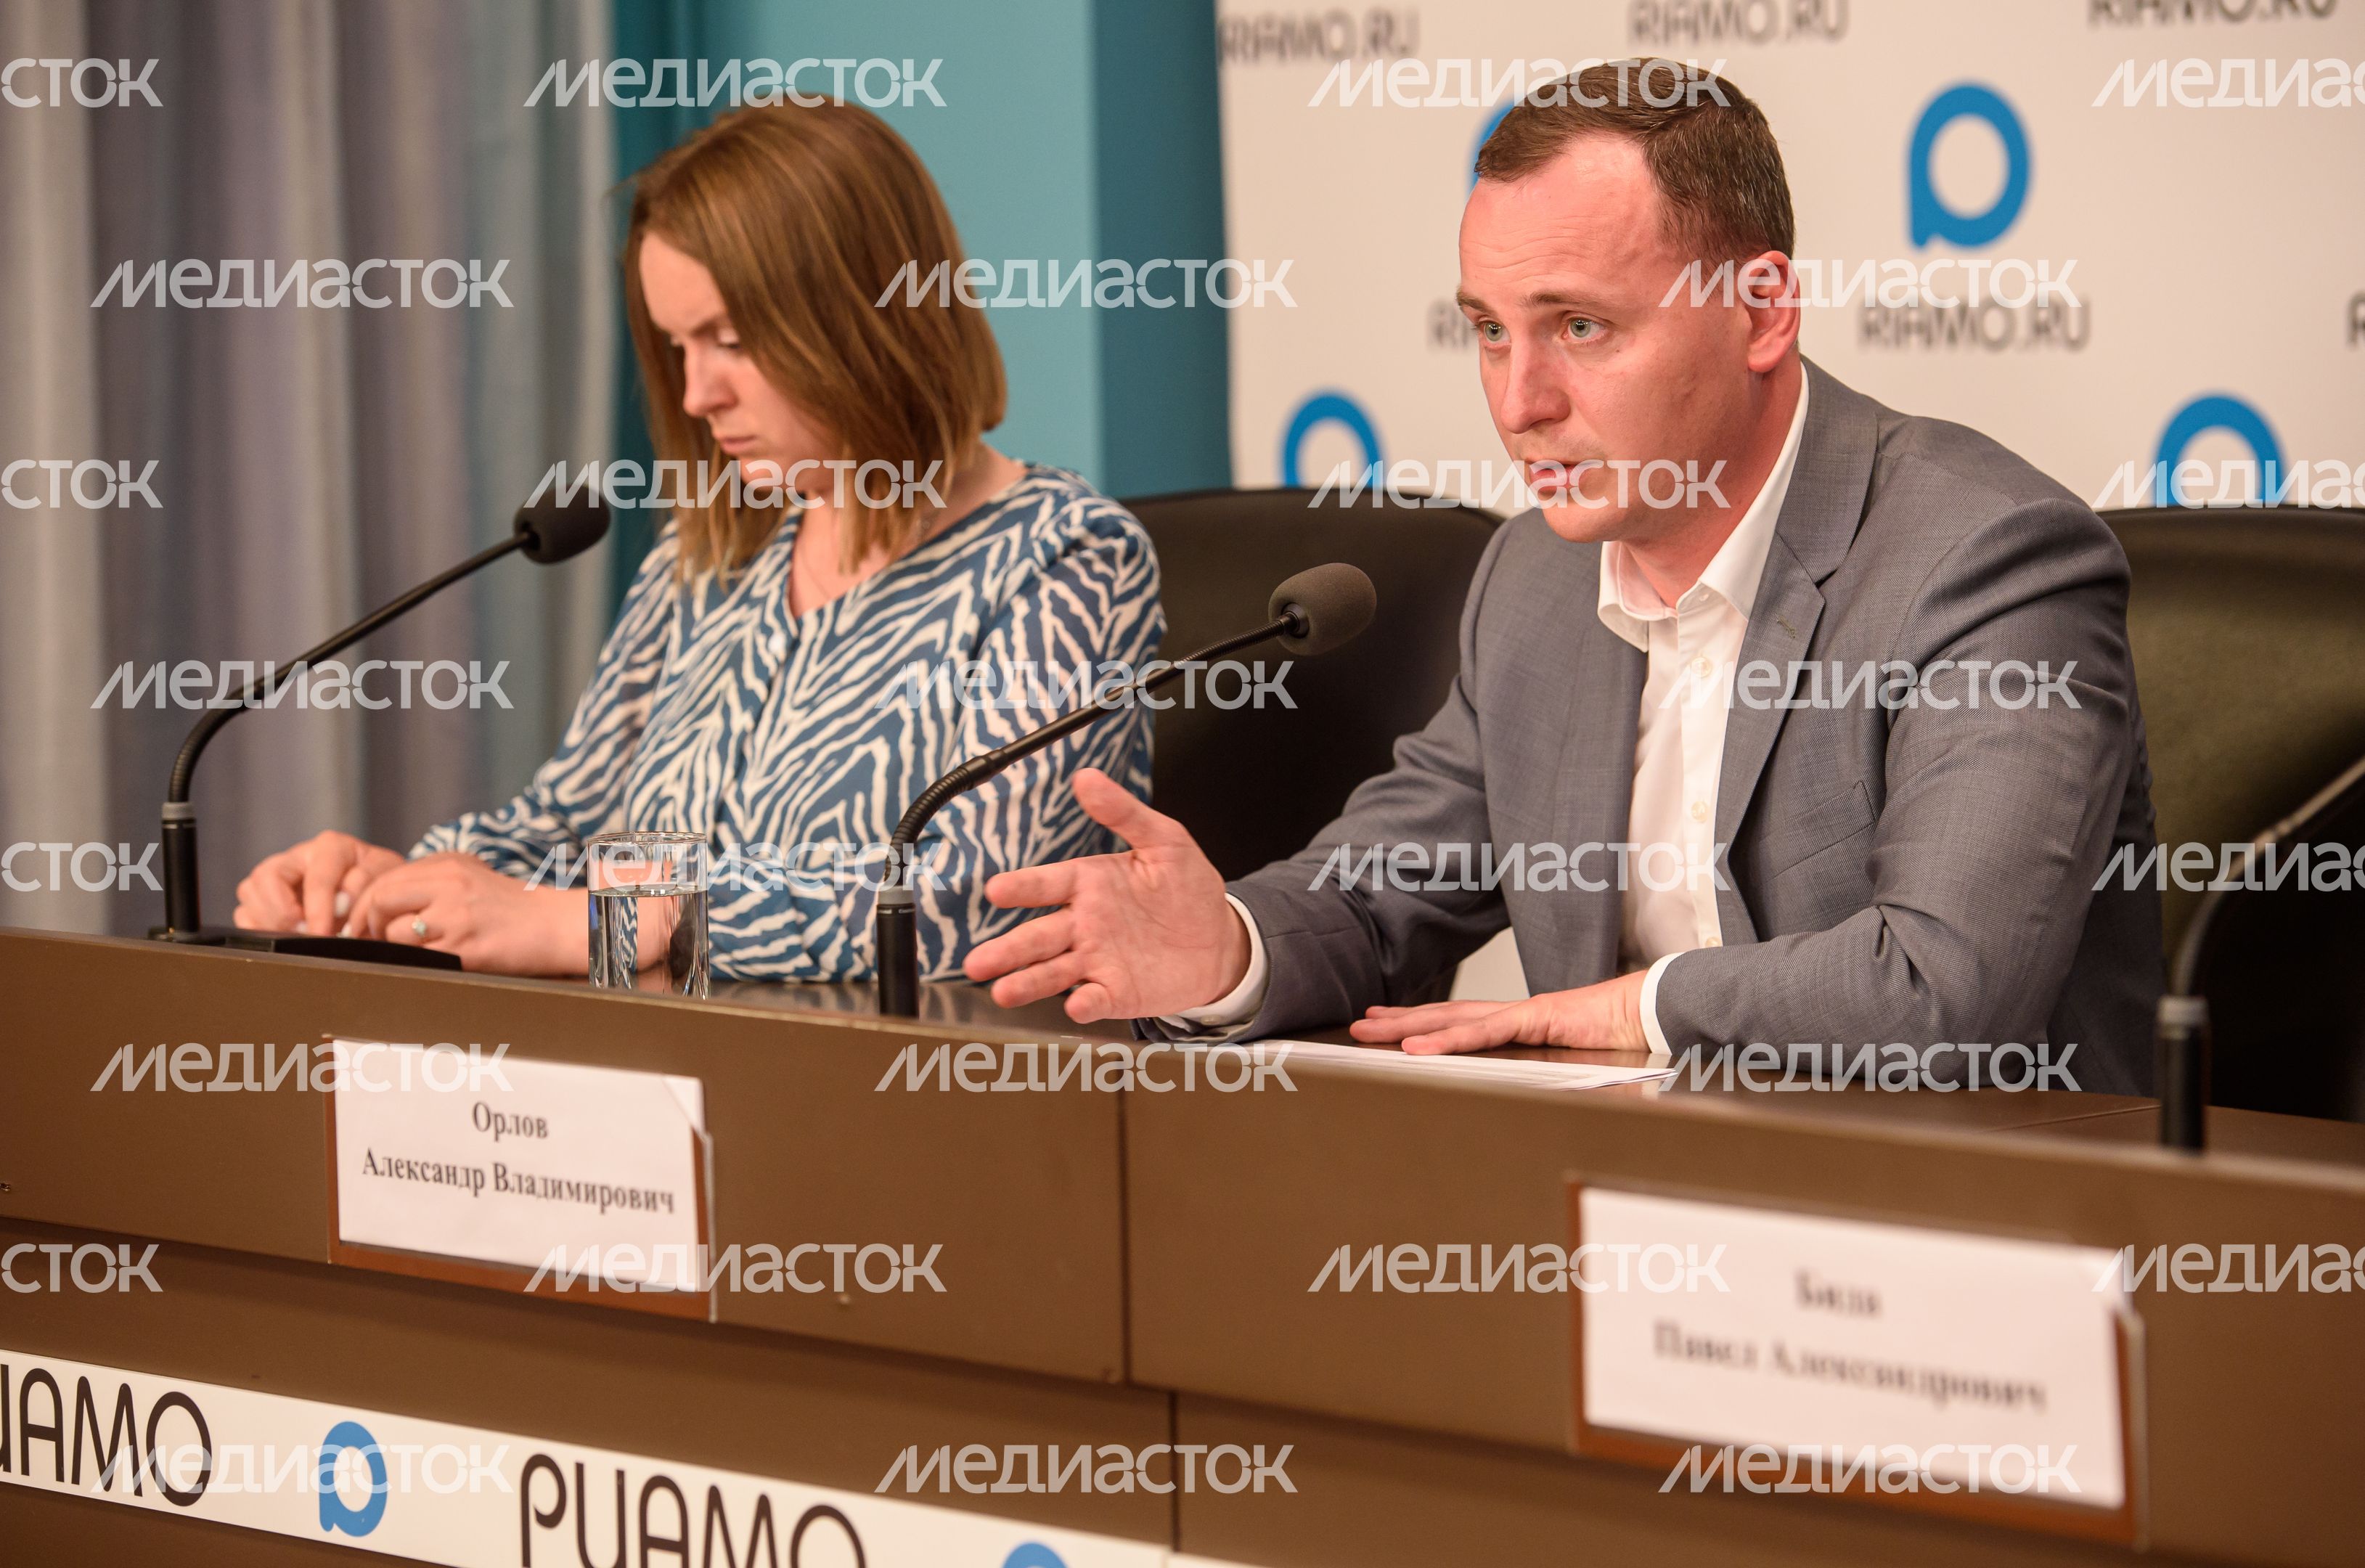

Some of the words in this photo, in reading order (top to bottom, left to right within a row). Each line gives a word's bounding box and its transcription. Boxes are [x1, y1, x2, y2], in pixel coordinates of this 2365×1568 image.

[473, 1101, 550, 1142] Орлов
[362, 1147, 485, 1198] Александр
[491, 1162, 675, 1215] Владимирович
